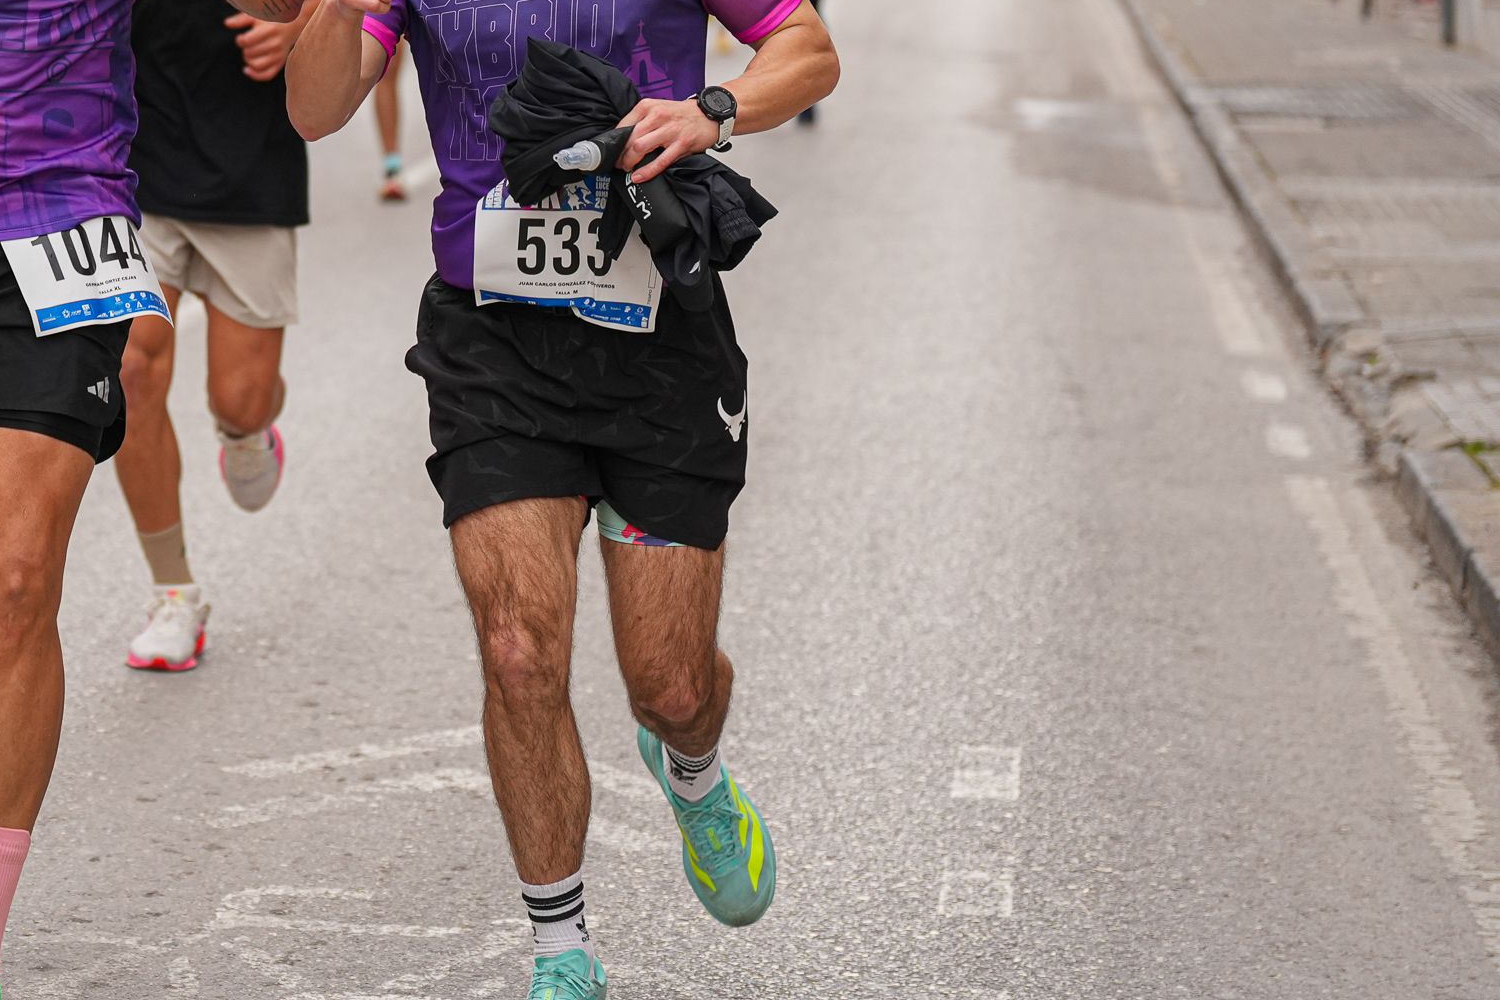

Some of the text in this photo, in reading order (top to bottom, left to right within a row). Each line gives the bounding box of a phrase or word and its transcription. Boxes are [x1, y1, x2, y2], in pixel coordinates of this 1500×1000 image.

[595, 198, 607, 209] 20
[31, 217, 148, 282] 1044
[517, 217, 612, 276] 533
